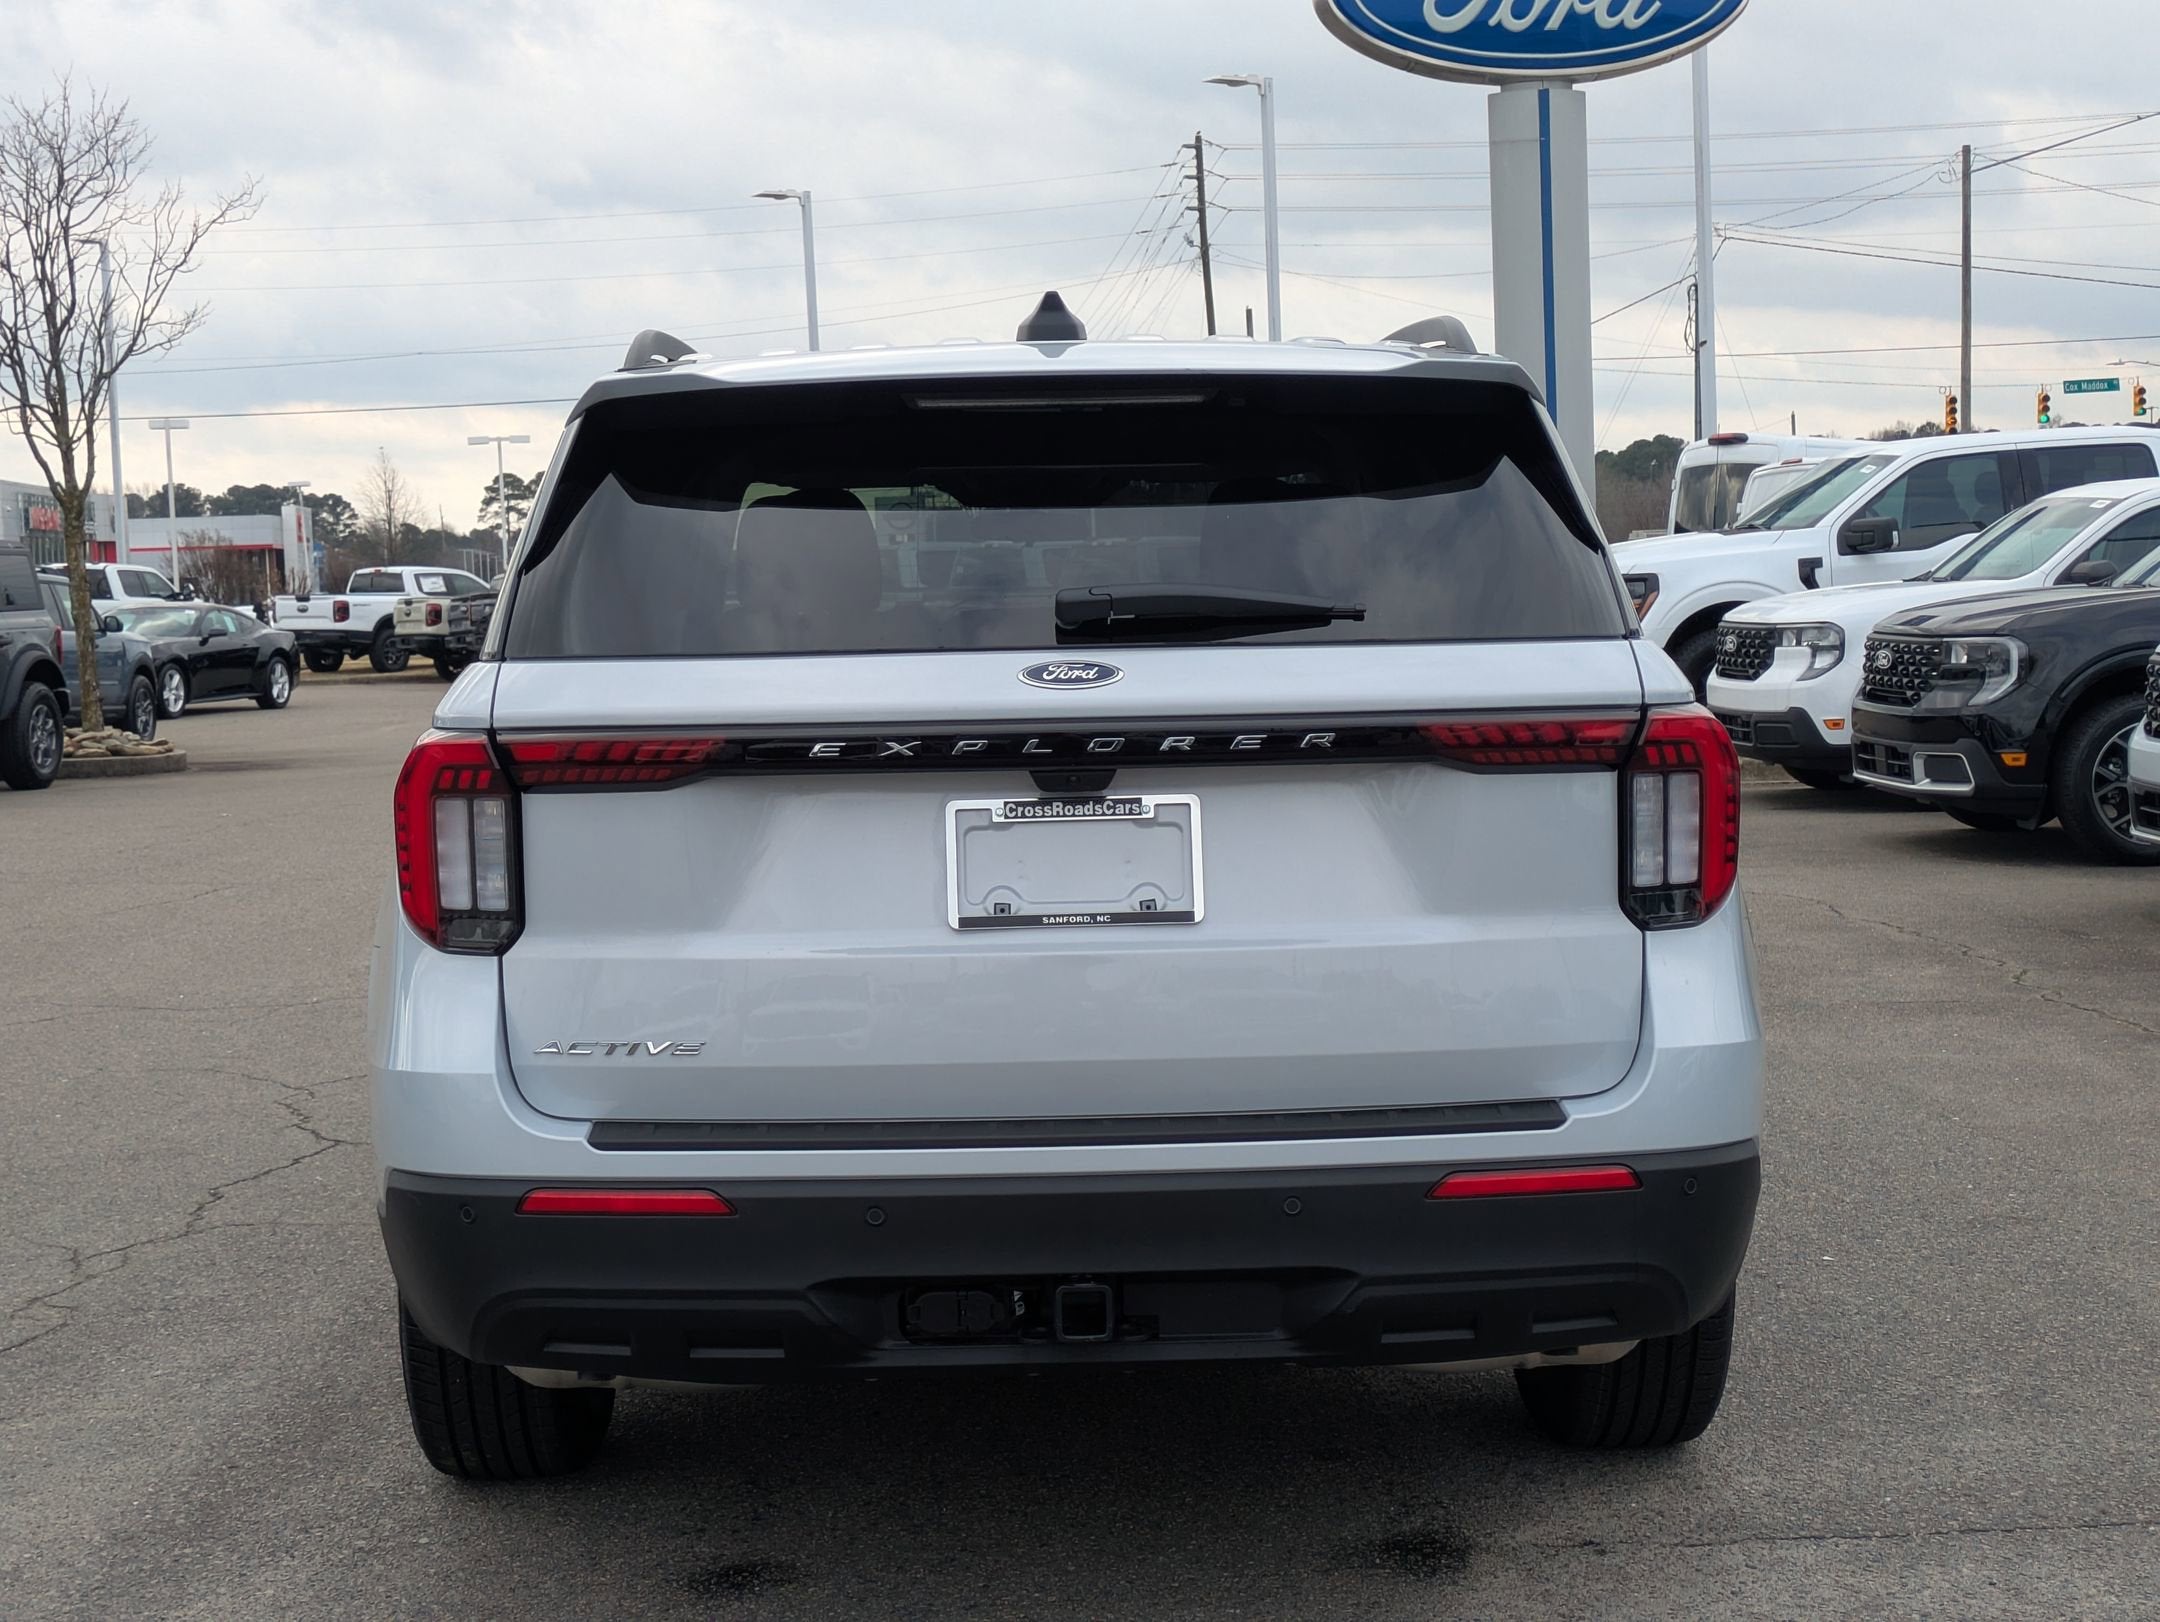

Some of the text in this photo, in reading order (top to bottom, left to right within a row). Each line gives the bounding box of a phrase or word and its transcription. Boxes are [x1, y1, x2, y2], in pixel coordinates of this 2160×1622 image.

[2064, 382, 2079, 392] Cox
[2081, 381, 2109, 391] Maddox
[1042, 663, 1099, 680] Ford
[808, 731, 1338, 757] EXPLORER
[1005, 801, 1141, 819] CrossRoadsCars
[1042, 915, 1112, 925] SANFORD, NC
[534, 1040, 706, 1056] ACTIVE
